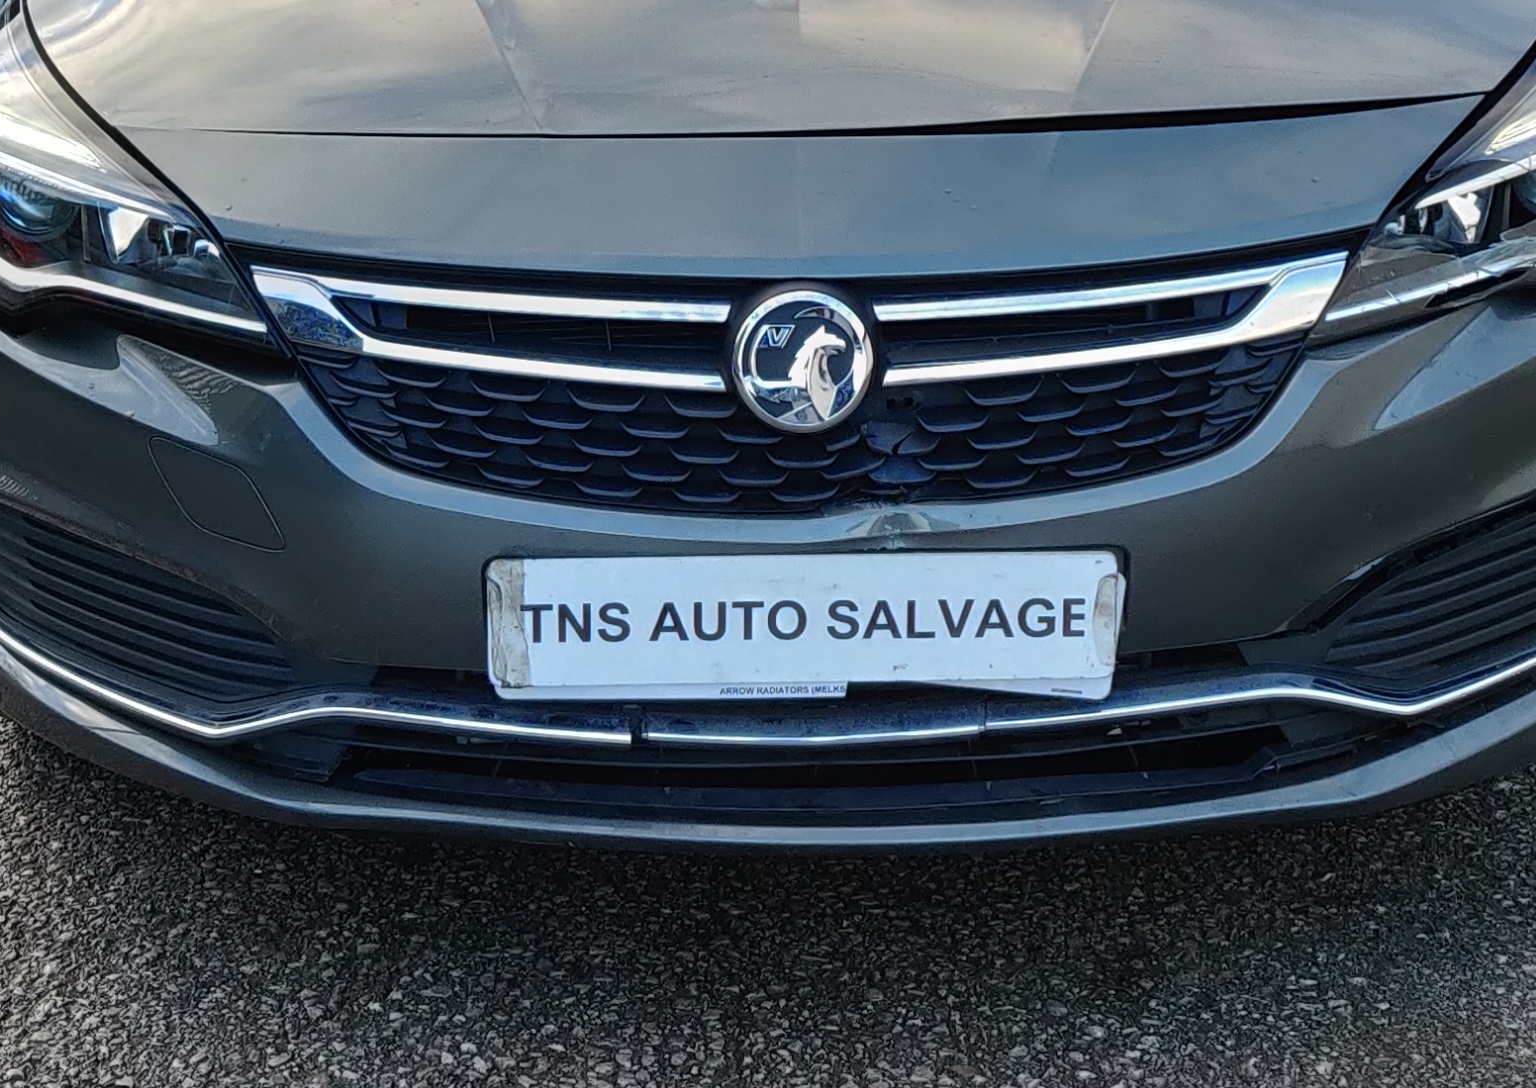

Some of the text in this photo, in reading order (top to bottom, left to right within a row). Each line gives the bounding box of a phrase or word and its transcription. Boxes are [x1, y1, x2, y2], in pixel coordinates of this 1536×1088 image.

[520, 597, 1087, 644] TNS AUTO SALVAGE
[719, 686, 754, 696] ARROW
[756, 685, 809, 695] RADIATORS
